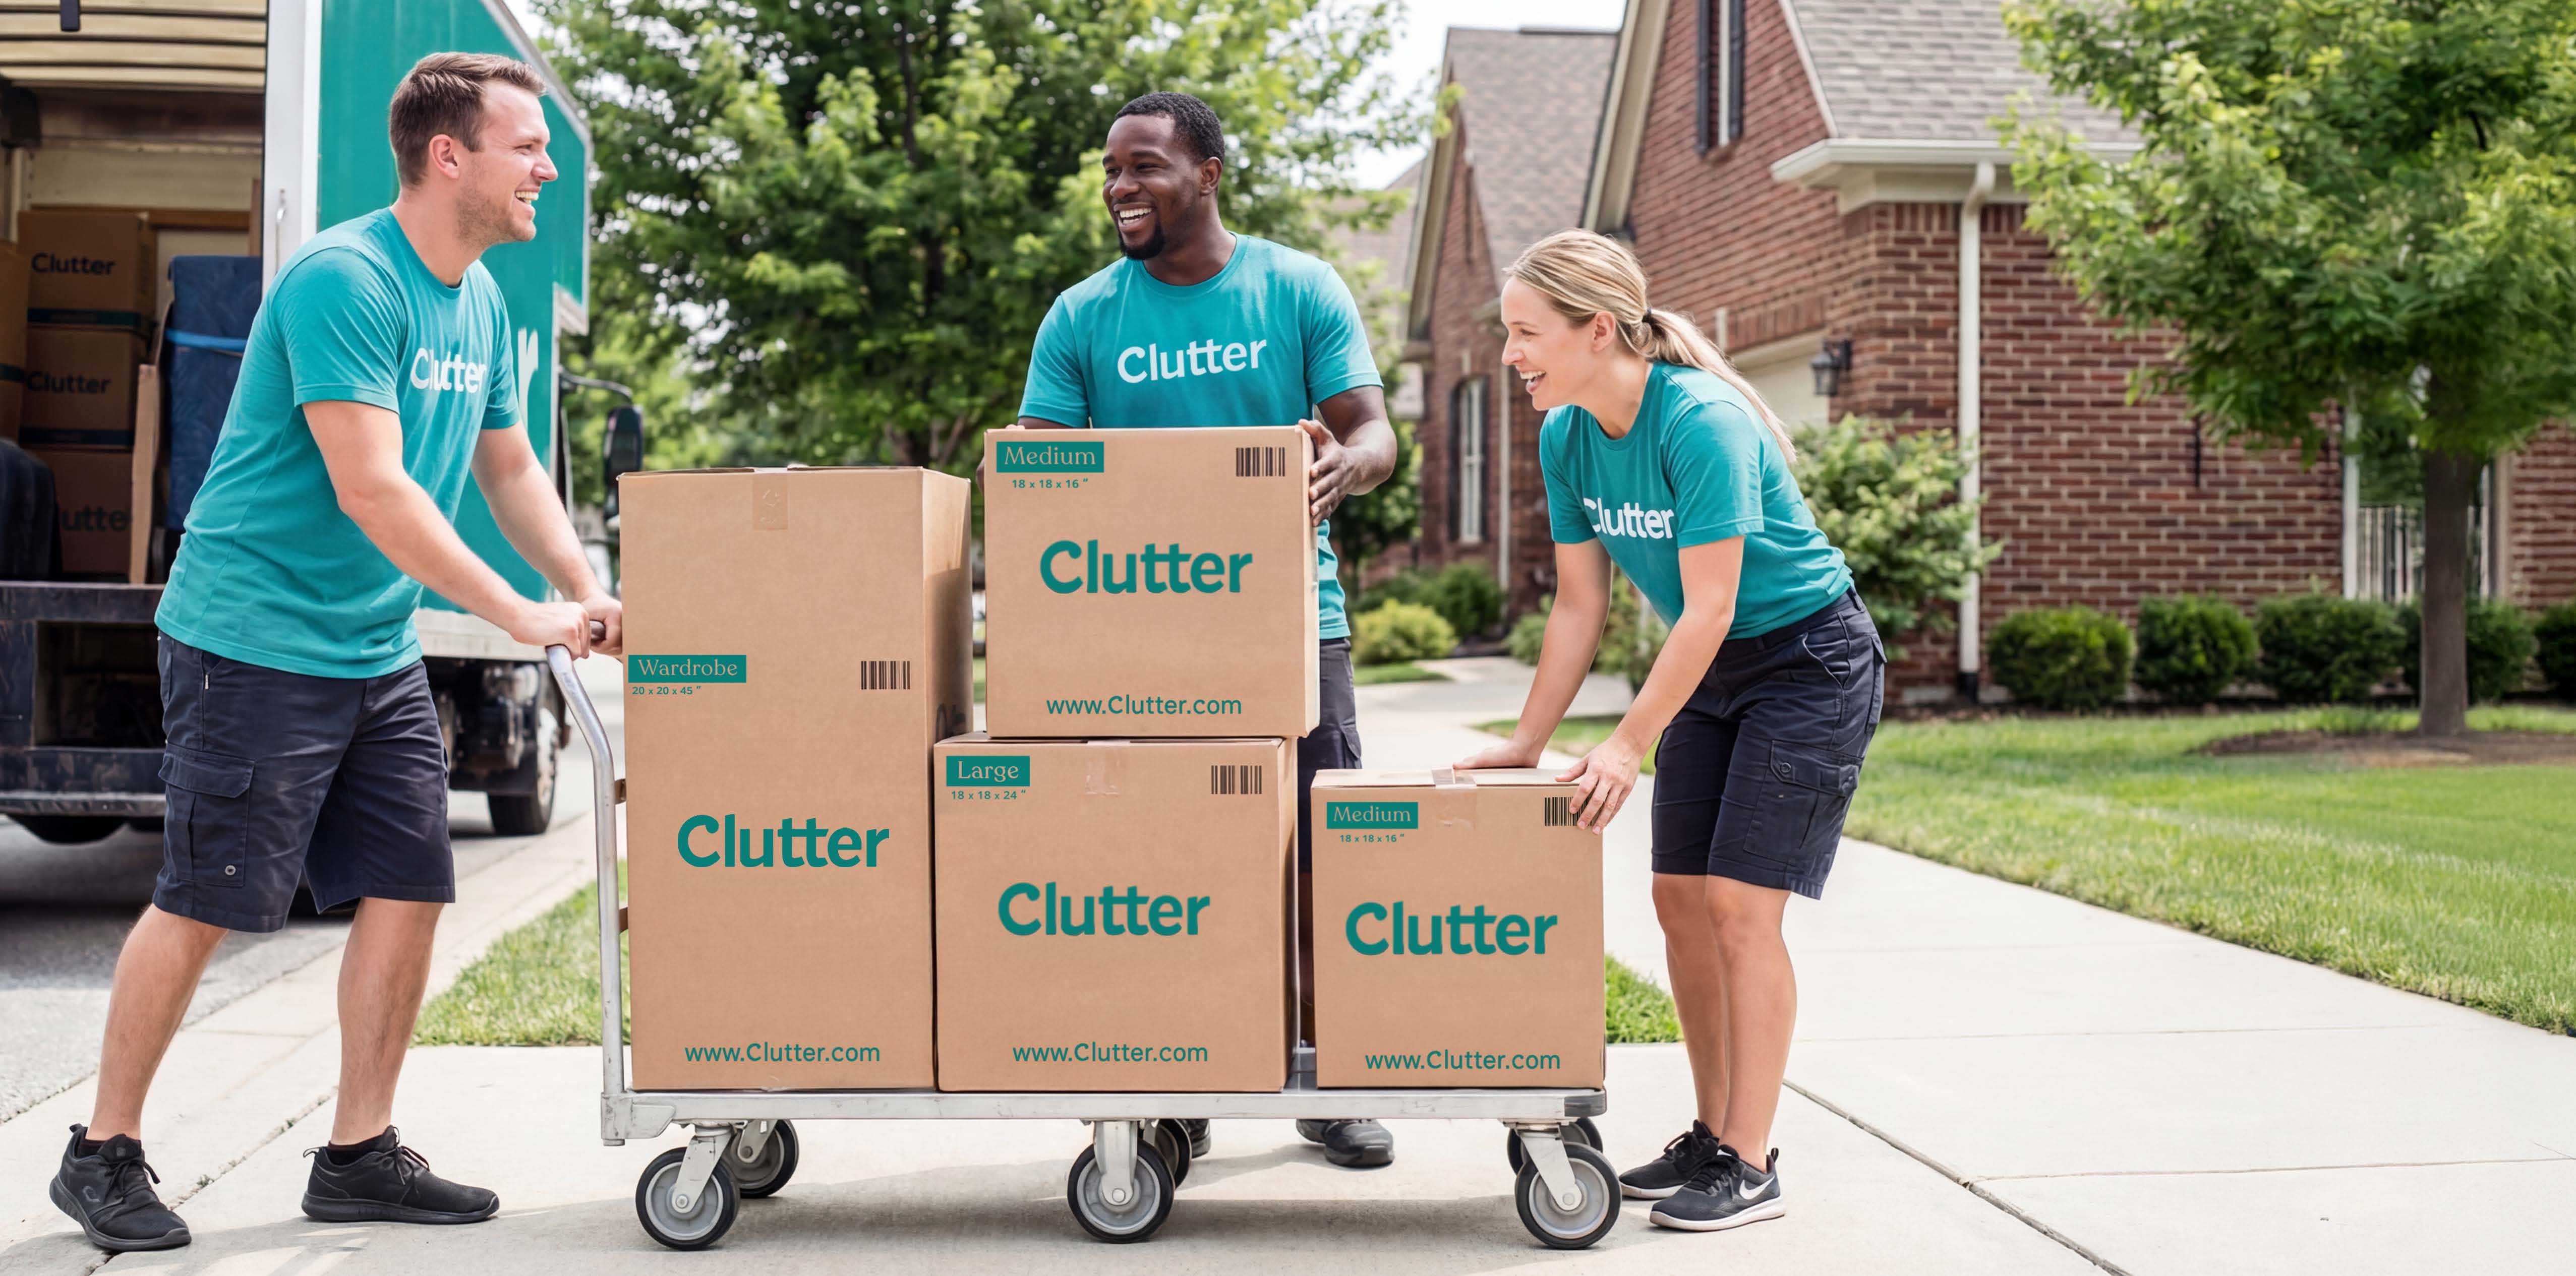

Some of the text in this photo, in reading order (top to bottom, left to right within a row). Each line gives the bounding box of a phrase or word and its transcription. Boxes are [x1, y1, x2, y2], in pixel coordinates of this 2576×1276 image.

[30, 252, 116, 275] Clutter
[411, 347, 487, 393] Clutter
[1118, 339, 1267, 383] Clutter
[27, 372, 112, 394] Clutter
[1005, 446, 1095, 465] Medium
[1012, 478, 1026, 489] 18
[1039, 478, 1053, 489] 18
[1065, 478, 1080, 489] 16
[62, 506, 130, 531] utte
[1039, 538, 1253, 594] Clutter
[638, 658, 738, 676] Wardrobe
[632, 686, 645, 695] 20
[656, 686, 669, 695] 20
[680, 686, 693, 695] 45
[1046, 694, 1242, 715] www.Clutter.com
[958, 761, 1019, 782] Large
[952, 791, 965, 800] 18
[978, 790, 991, 800] 18
[1004, 790, 1017, 800] 24
[1334, 806, 1411, 822] Medium
[677, 814, 890, 868] Clutter
[1340, 834, 1352, 842] 18
[1363, 833, 1374, 842] 18
[1385, 834, 1397, 842] 16
[998, 881, 1210, 936] Clutter
[1345, 900, 1558, 956] Clutter
[685, 1041, 880, 1062] www.Clutter.com
[1013, 1041, 1208, 1062] www.Clutter.com
[1365, 1049, 1560, 1069] www.Clutter.com
